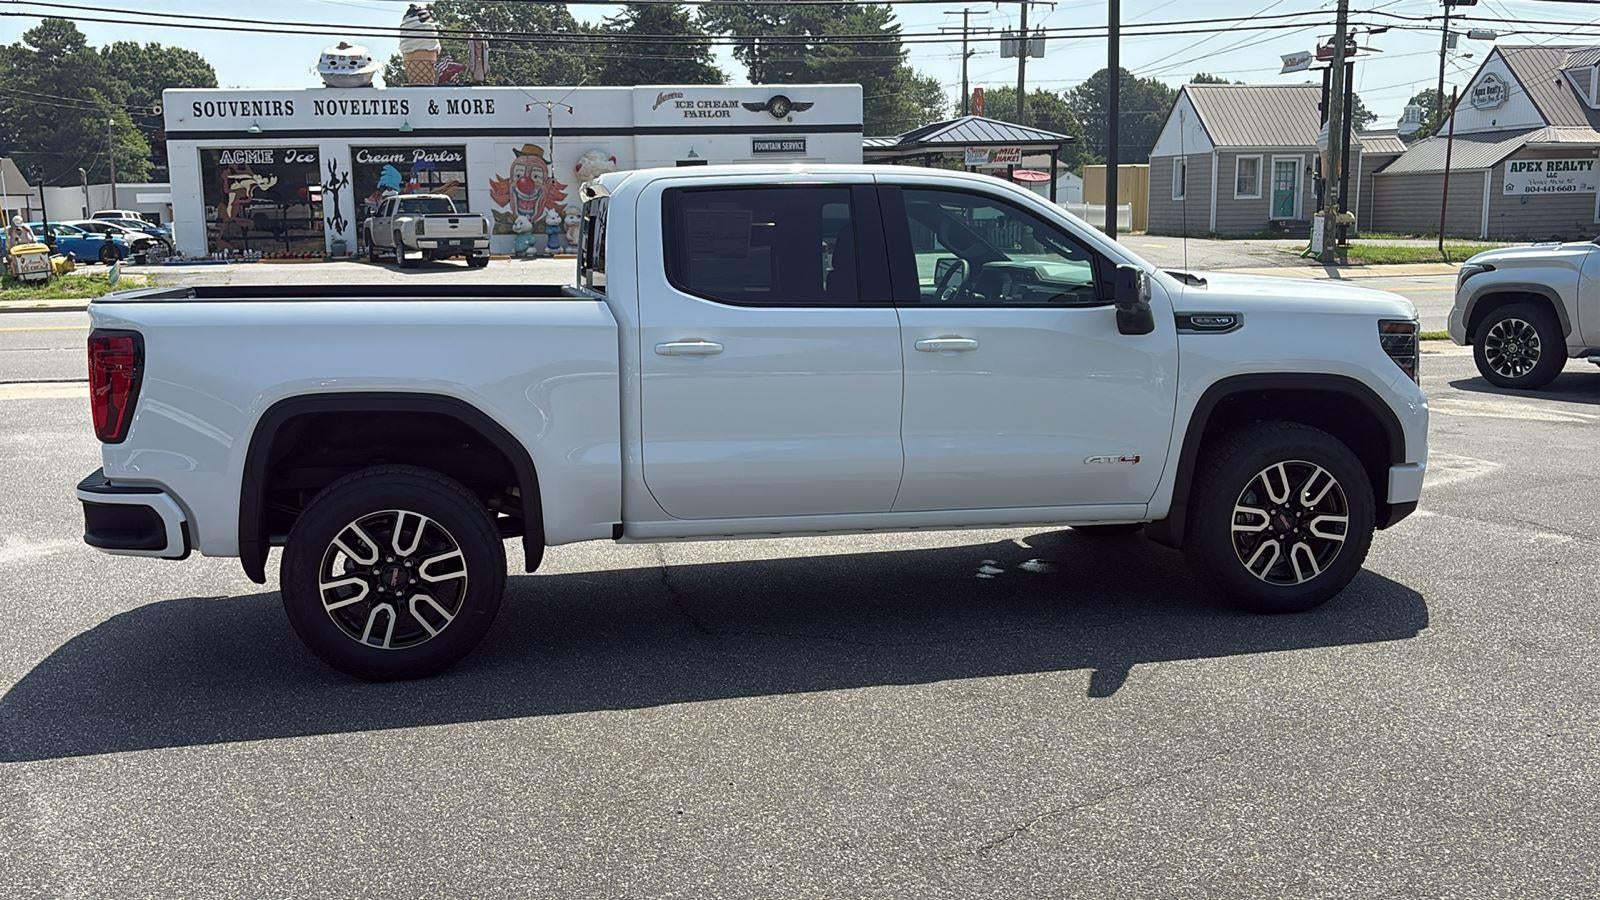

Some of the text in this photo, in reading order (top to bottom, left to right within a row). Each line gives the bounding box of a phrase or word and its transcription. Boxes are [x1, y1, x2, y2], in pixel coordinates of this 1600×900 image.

[192, 99, 495, 118] SOUVENIRS NOVELTIES & MORE
[675, 100, 739, 109] ICE CREAM
[684, 110, 731, 118] PARLOR
[754, 142, 805, 151] FOUNTAIN SERVICE
[219, 150, 316, 165] ACME Ice
[356, 149, 463, 164] Cream Parlor
[1510, 160, 1594, 173] APEX REALTY
